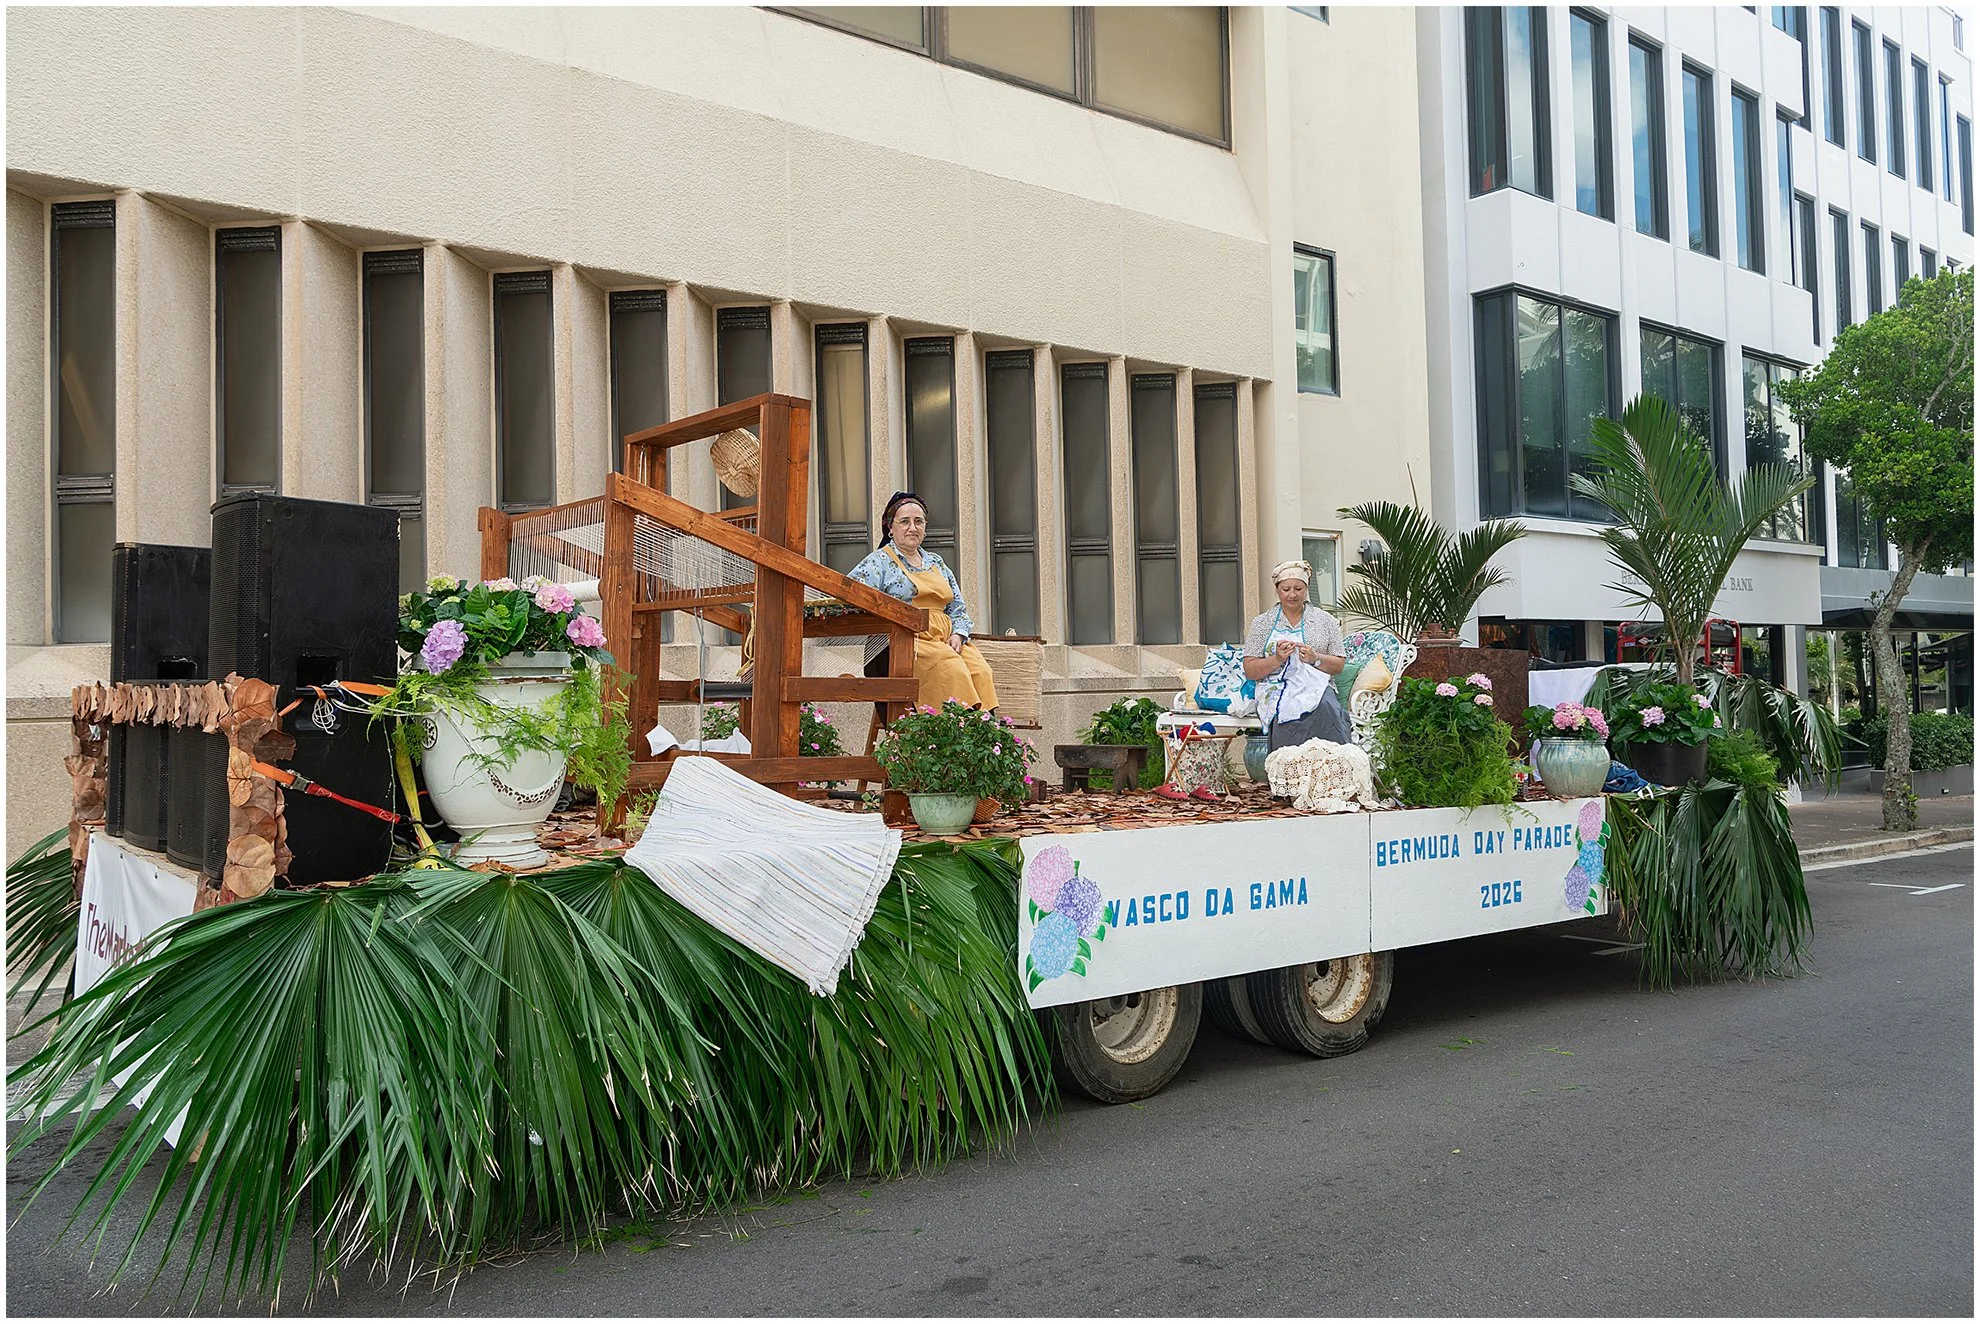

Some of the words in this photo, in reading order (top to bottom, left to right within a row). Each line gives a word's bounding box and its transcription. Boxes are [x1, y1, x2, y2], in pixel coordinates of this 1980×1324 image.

[1729, 577, 1754, 592] BANK
[1376, 834, 1460, 867] BERMUDA
[1474, 831, 1505, 855] DAY
[1513, 823, 1573, 850] PARADE
[1107, 890, 1189, 928] VASCO
[1205, 887, 1234, 917] DA
[1249, 877, 1308, 910] GAMA
[1480, 880, 1522, 909] 2026
